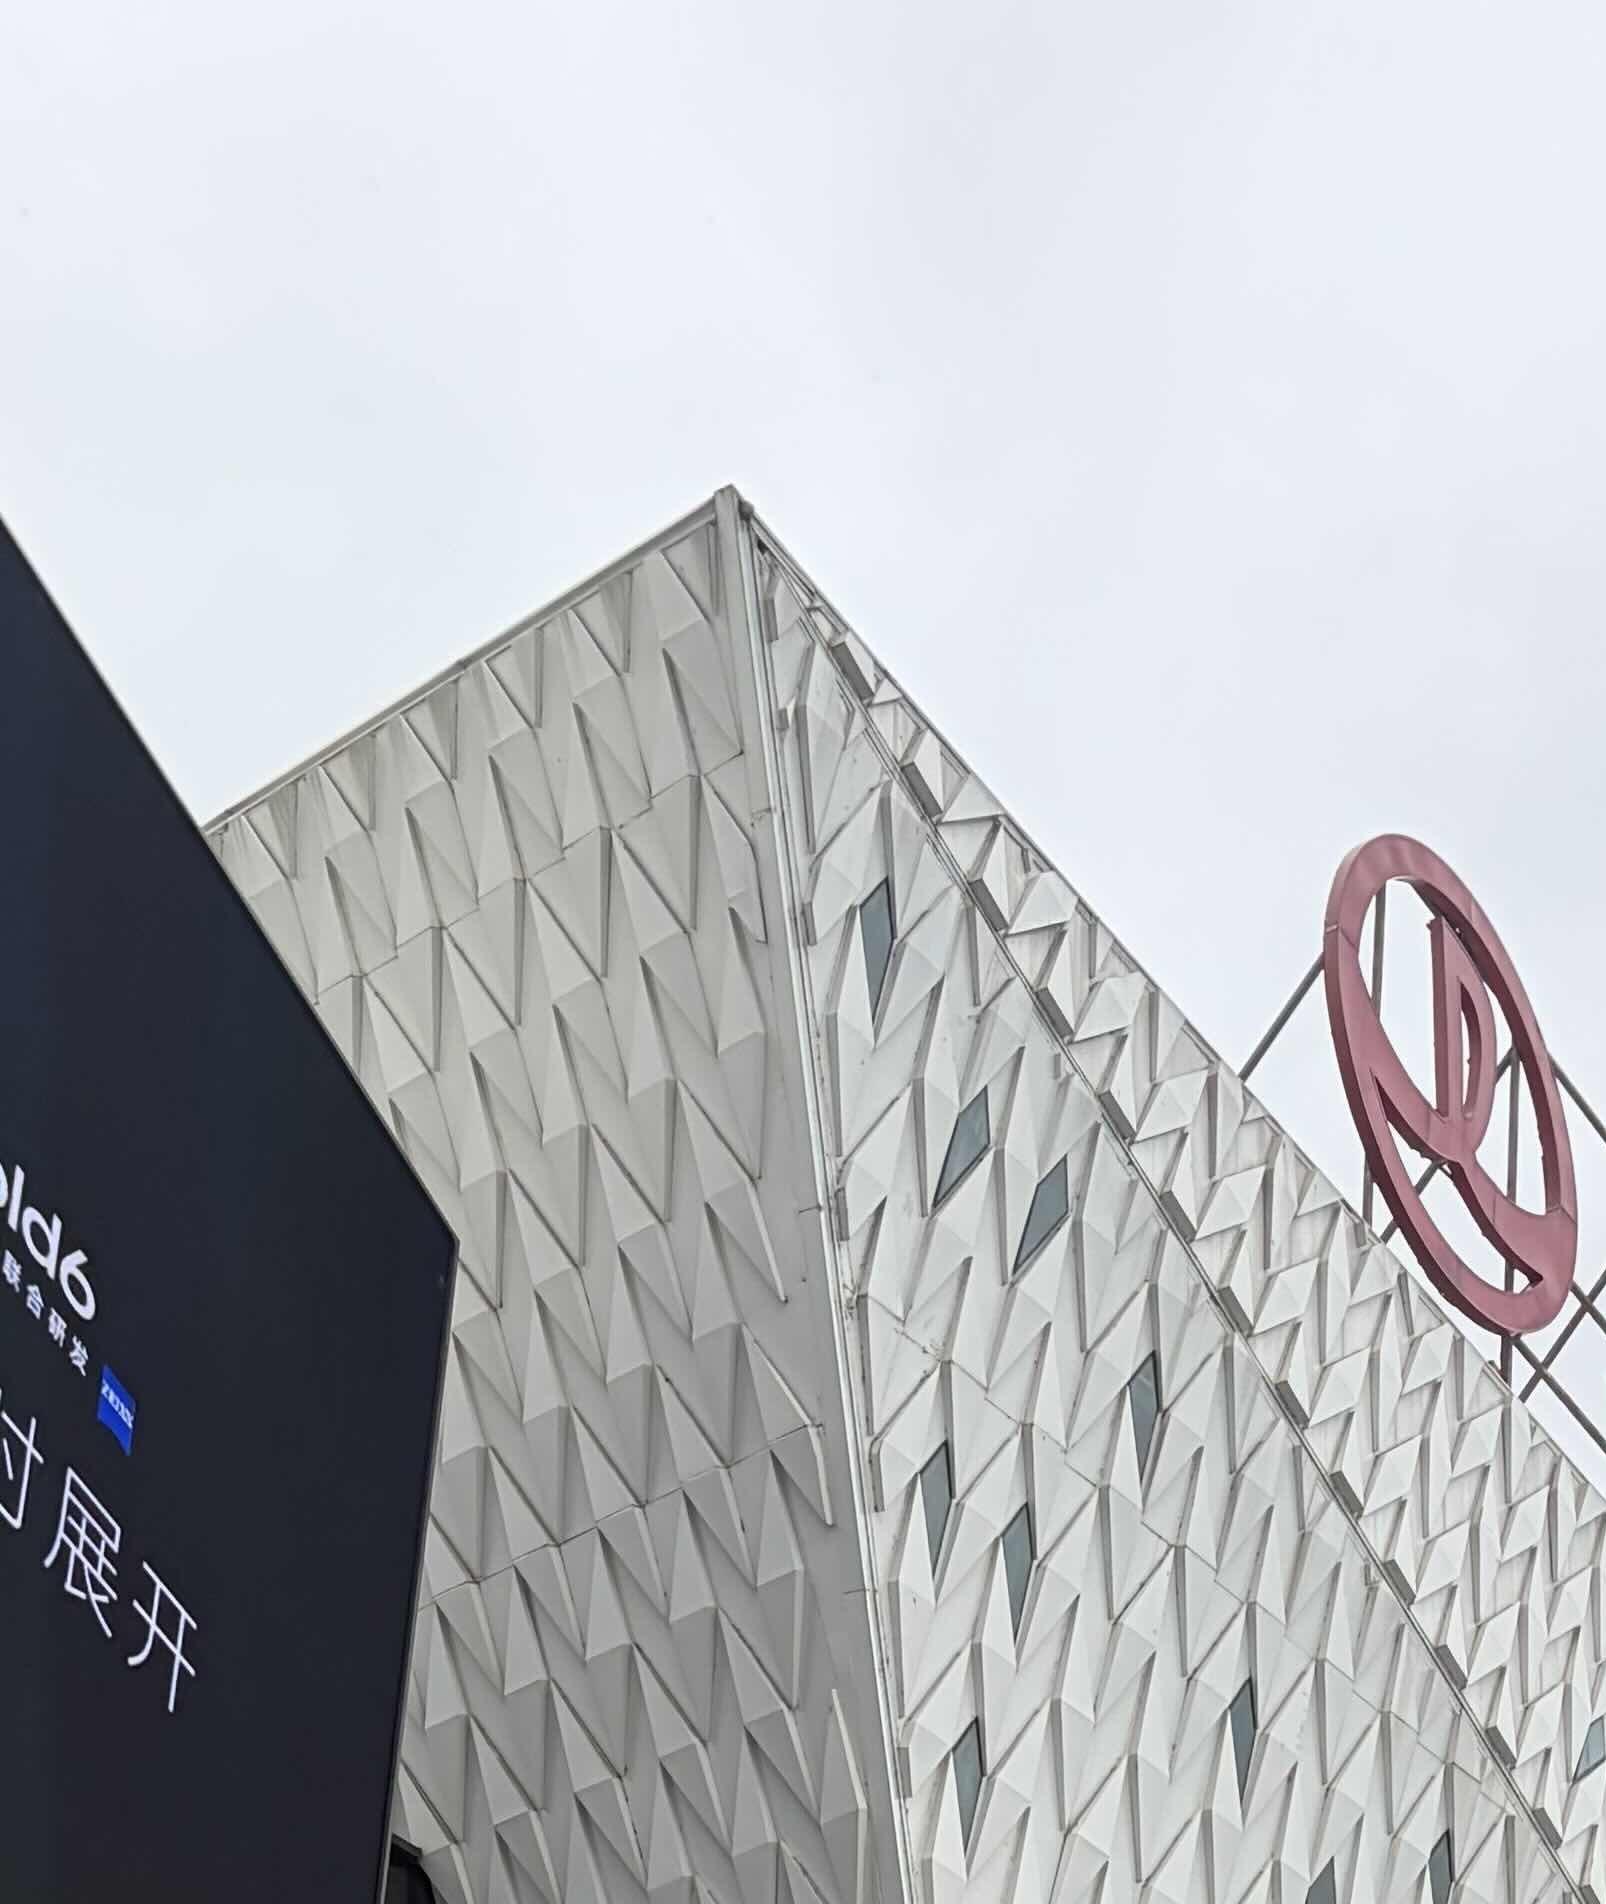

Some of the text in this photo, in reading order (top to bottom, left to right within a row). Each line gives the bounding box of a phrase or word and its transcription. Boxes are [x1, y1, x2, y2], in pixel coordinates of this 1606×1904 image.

[0, 1160, 96, 1322] ld6
[2, 1249, 89, 1377] 联合研发
